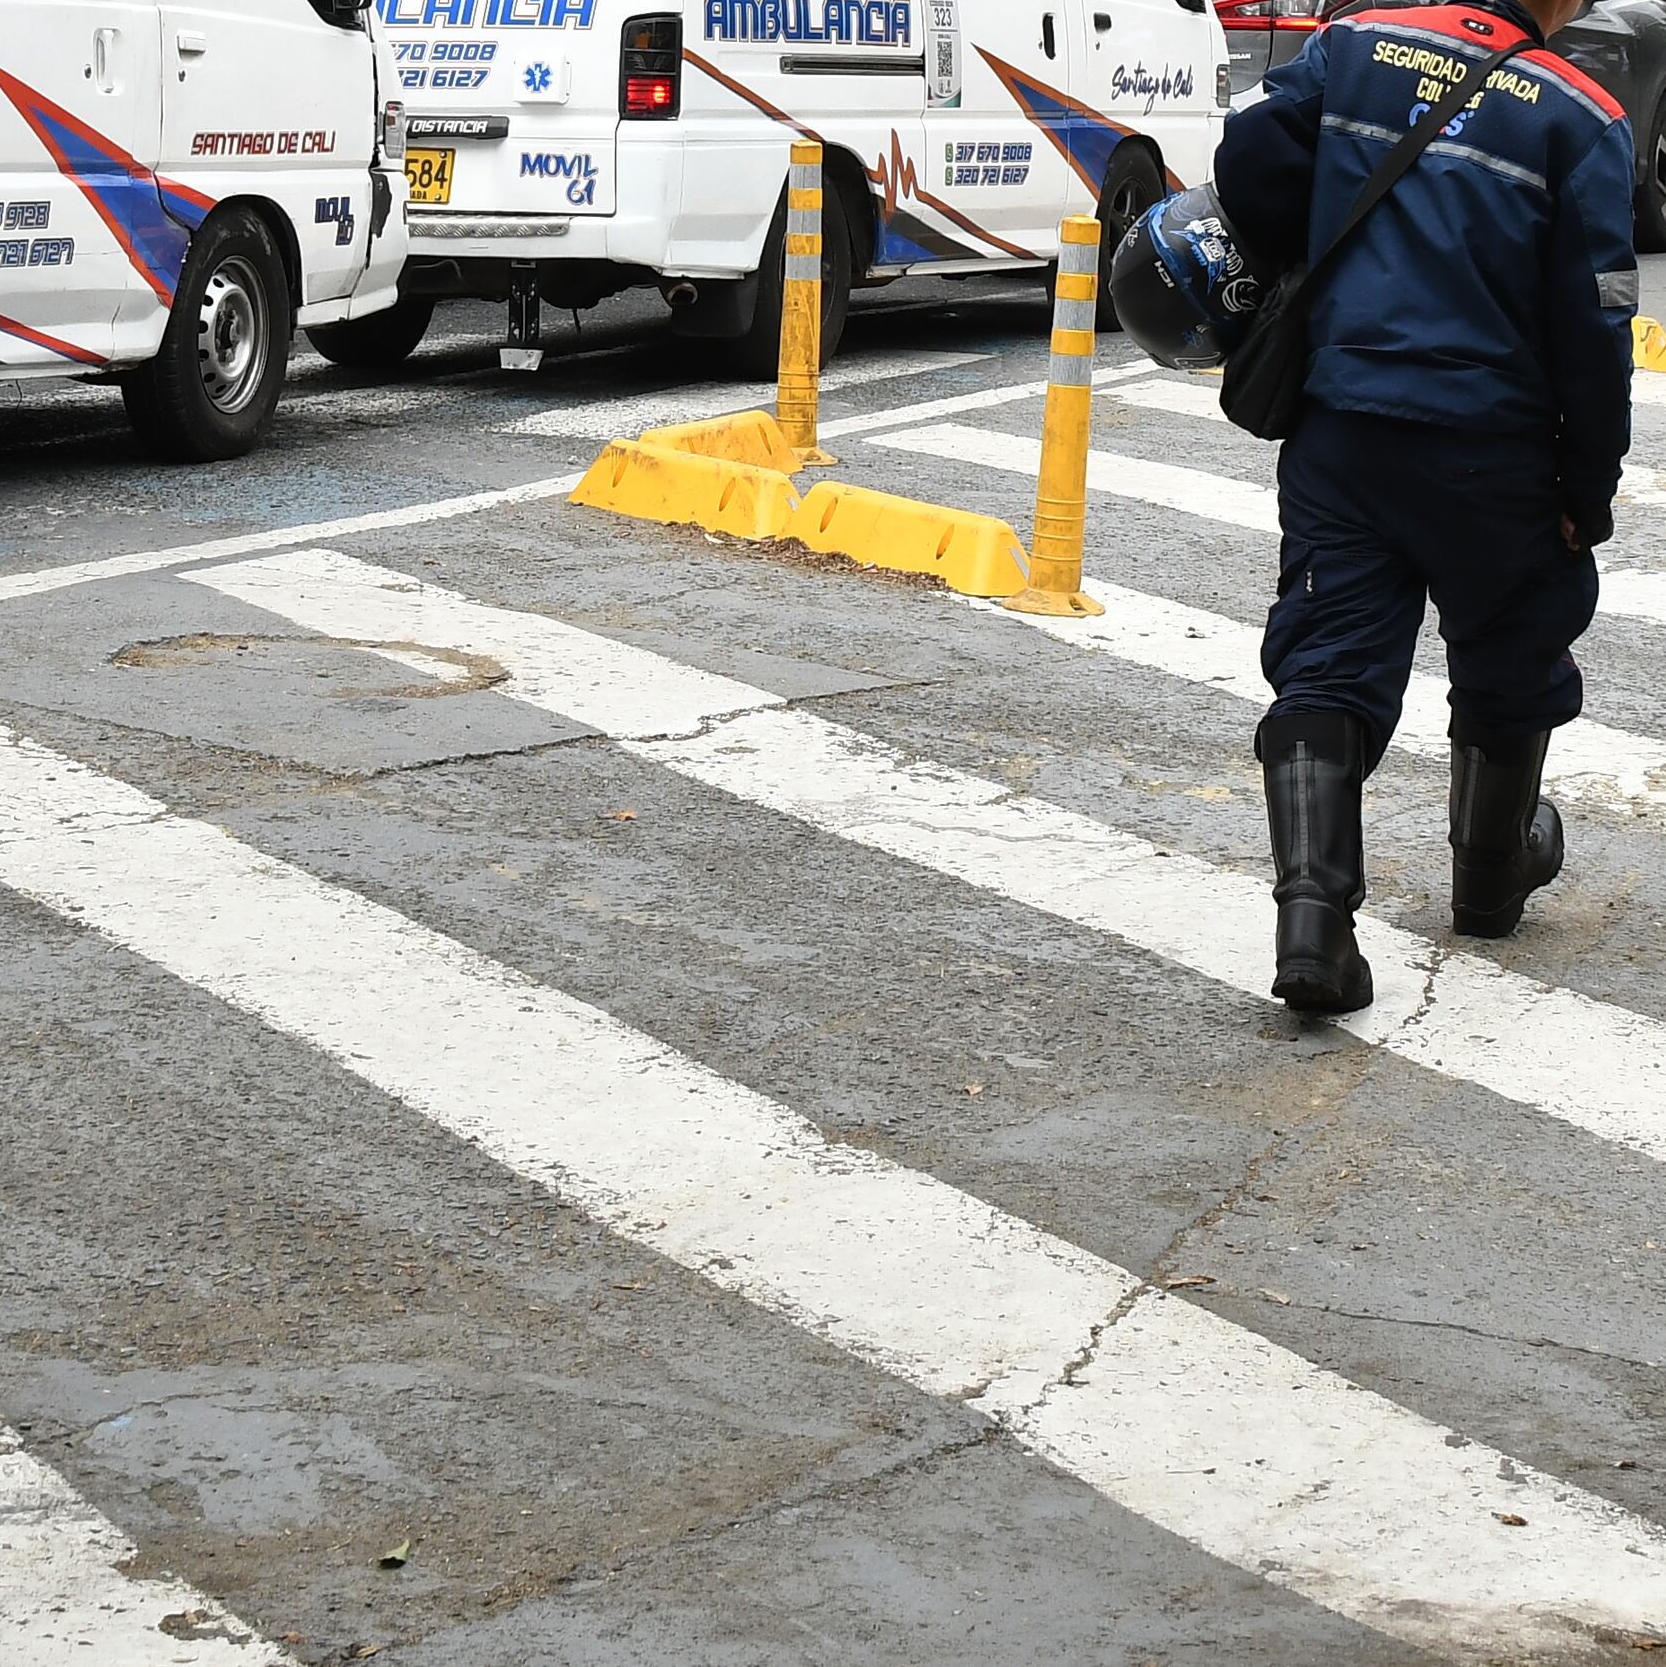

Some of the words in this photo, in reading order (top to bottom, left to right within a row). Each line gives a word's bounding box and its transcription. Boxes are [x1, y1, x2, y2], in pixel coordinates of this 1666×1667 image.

[934, 7, 953, 27] 323
[392, 41, 428, 62] 70
[429, 41, 498, 62] 9008
[1373, 40, 1467, 83] SEGURIDAD
[431, 67, 490, 89] 6127
[412, 119, 488, 133] DISTANCIA
[191, 131, 274, 156] SANTIAGO
[276, 131, 300, 154] DE
[301, 130, 336, 153] CALI
[955, 143, 976, 163] 317
[977, 143, 1000, 163] 670
[1001, 143, 1032, 163] 9008
[519, 152, 599, 179] MOVIL
[954, 166, 980, 186] 320
[980, 166, 1001, 186] 721
[1001, 165, 1029, 185] 6127
[3, 201, 51, 230] 9128
[27, 238, 74, 266] 6127
